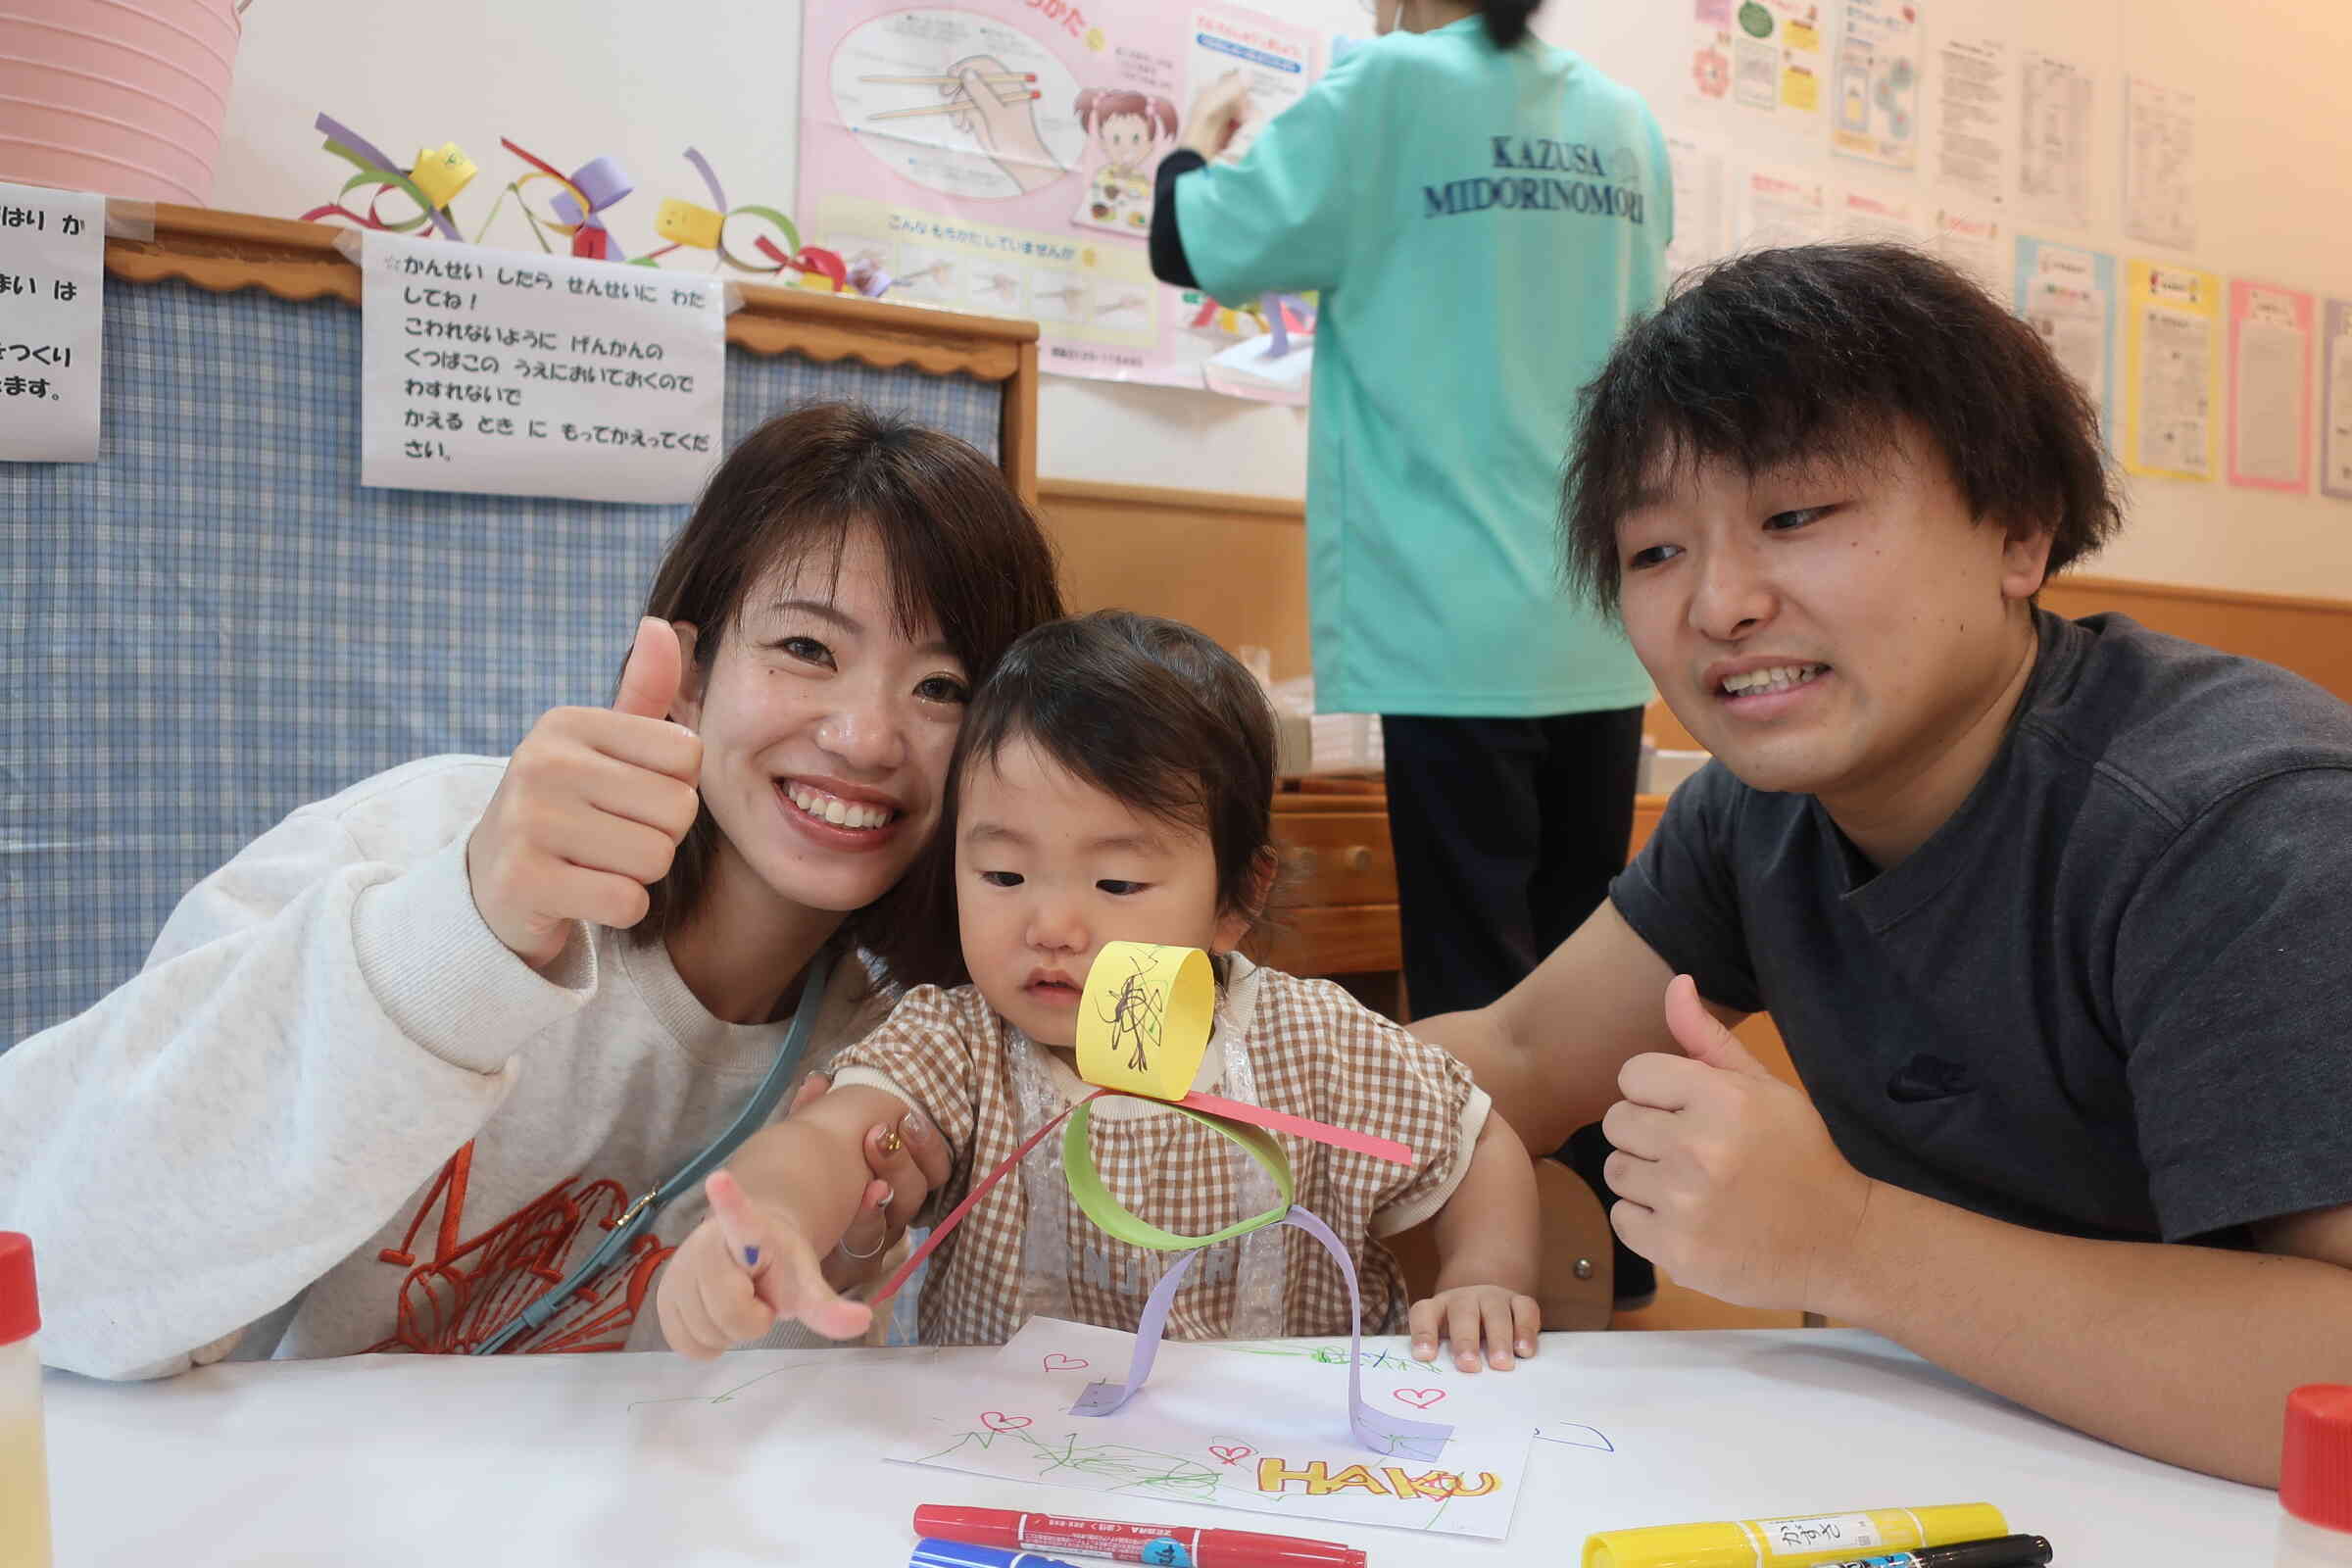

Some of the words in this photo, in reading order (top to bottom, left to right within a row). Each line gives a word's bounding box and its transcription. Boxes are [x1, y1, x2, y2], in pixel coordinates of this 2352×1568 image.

[1491, 135, 1606, 176] KAZUSA
[1422, 176, 1644, 224] MIDORINOMORI
[0, 205, 45, 231] はり
[54, 280, 77, 301] は
[404, 256, 483, 280] かんせい
[497, 268, 553, 290] したら
[566, 274, 658, 303] せんせいに
[671, 288, 707, 310] わた
[0, 343, 71, 368] つくり
[405, 317, 557, 351] こわれないように
[570, 335, 664, 362] げんかんの
[0, 375, 59, 401] ます。
[405, 377, 522, 407] わすれないで
[514, 358, 695, 393] うえにおいておくので
[404, 408, 464, 431] かえる
[477, 416, 514, 436] とき
[528, 419, 548, 438] に
[562, 422, 710, 453] もってかえってくだ
[404, 439, 455, 463] さい。
[1257, 1457, 1499, 1500] HAKU
